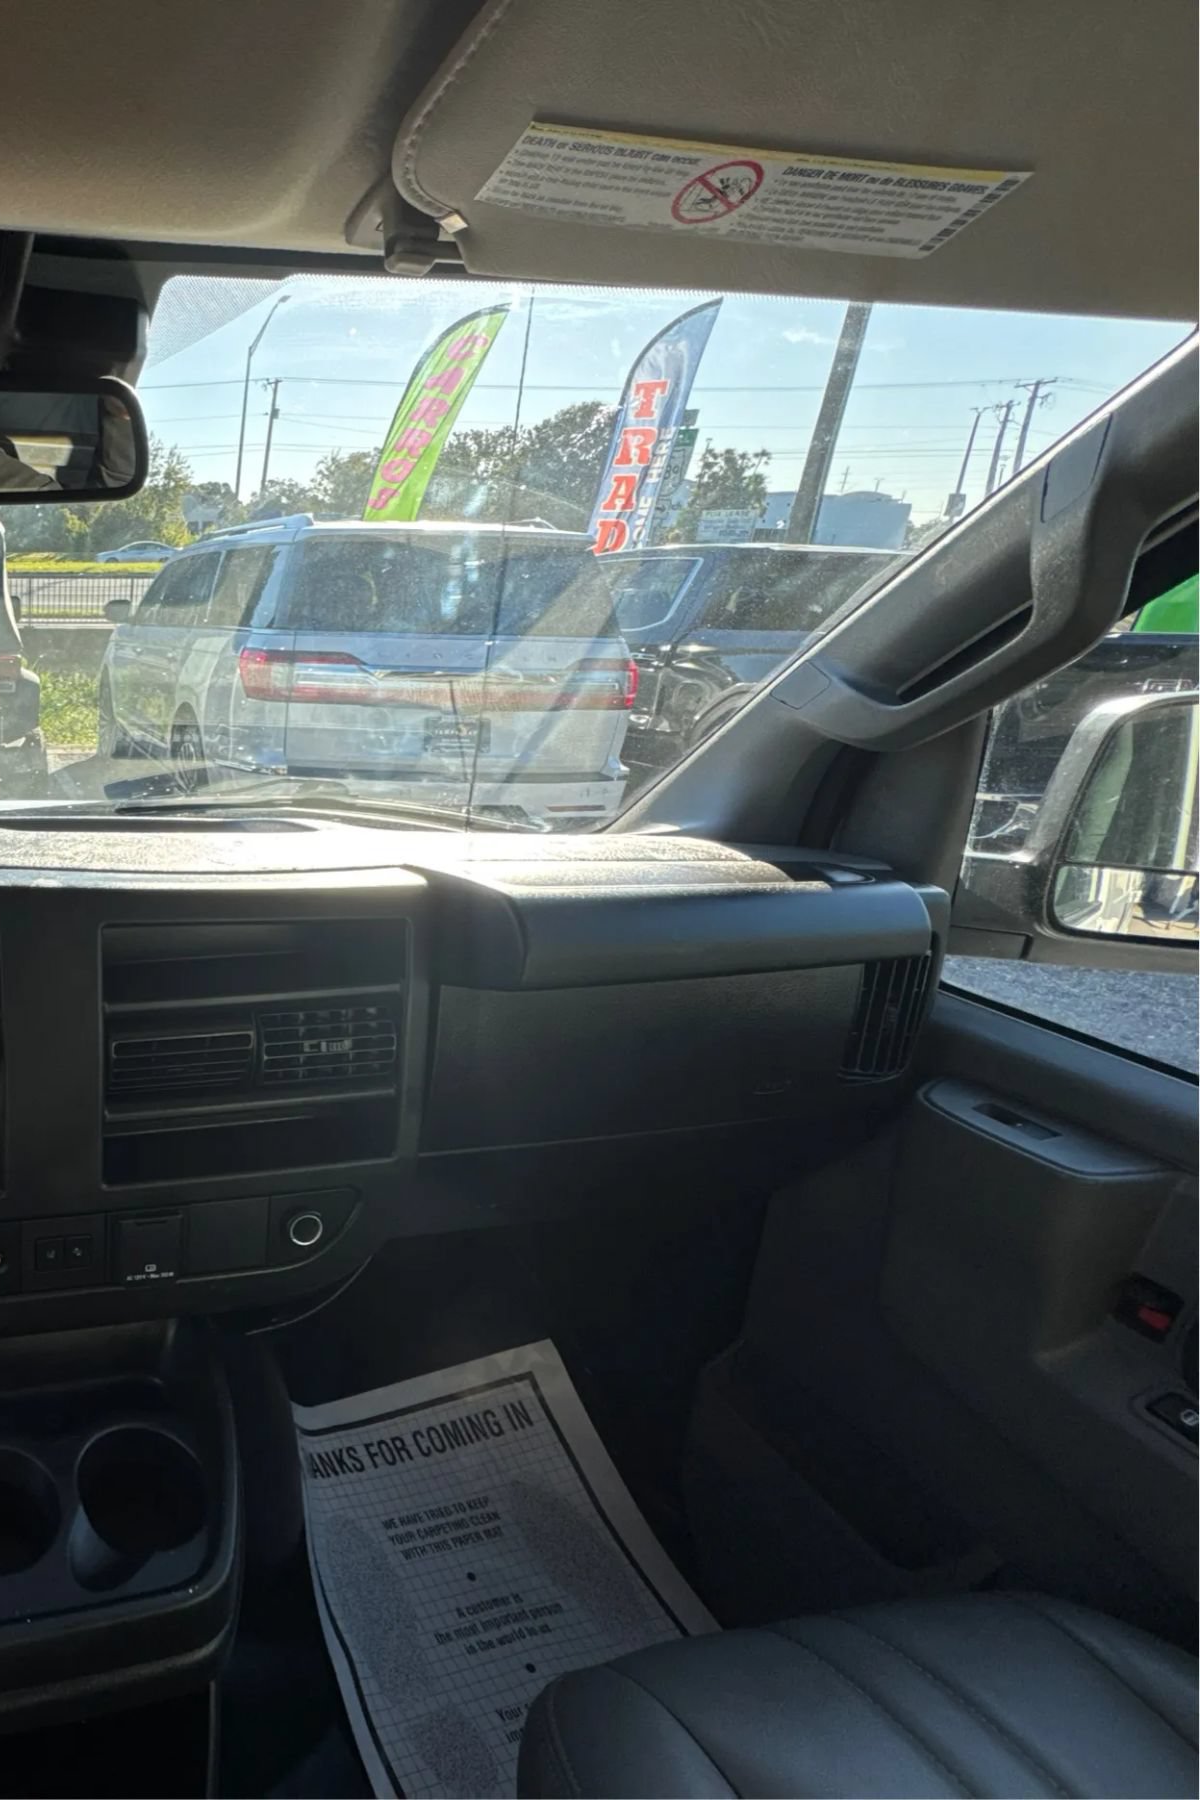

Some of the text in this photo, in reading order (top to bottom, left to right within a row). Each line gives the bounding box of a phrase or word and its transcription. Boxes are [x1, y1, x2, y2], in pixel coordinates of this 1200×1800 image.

[521, 135, 557, 149] DEATH
[569, 142, 614, 156] SERIOUS
[782, 166, 824, 178] DANGER
[838, 171, 867, 183] MORT
[893, 177, 950, 191] BLESSURES
[646, 428, 677, 484] HERE
[363, 1437, 414, 1470] FOR
[411, 1408, 505, 1459] COMING
[501, 1400, 534, 1432] IN
[382, 1518, 398, 1530] WE
[398, 1512, 424, 1527] HAVE
[451, 1502, 466, 1514] TO
[465, 1496, 489, 1511] KEEP
[389, 1511, 501, 1546] YOUR CARPETING CLEAN
[401, 1544, 427, 1561] WITH
[426, 1540, 453, 1554] THIS
[451, 1531, 485, 1549] PAPER
[434, 1631, 453, 1645] the
[453, 1623, 480, 1640] most
[479, 1608, 530, 1633] important
[496, 1626, 527, 1646] world
[495, 1705, 525, 1722] Your
